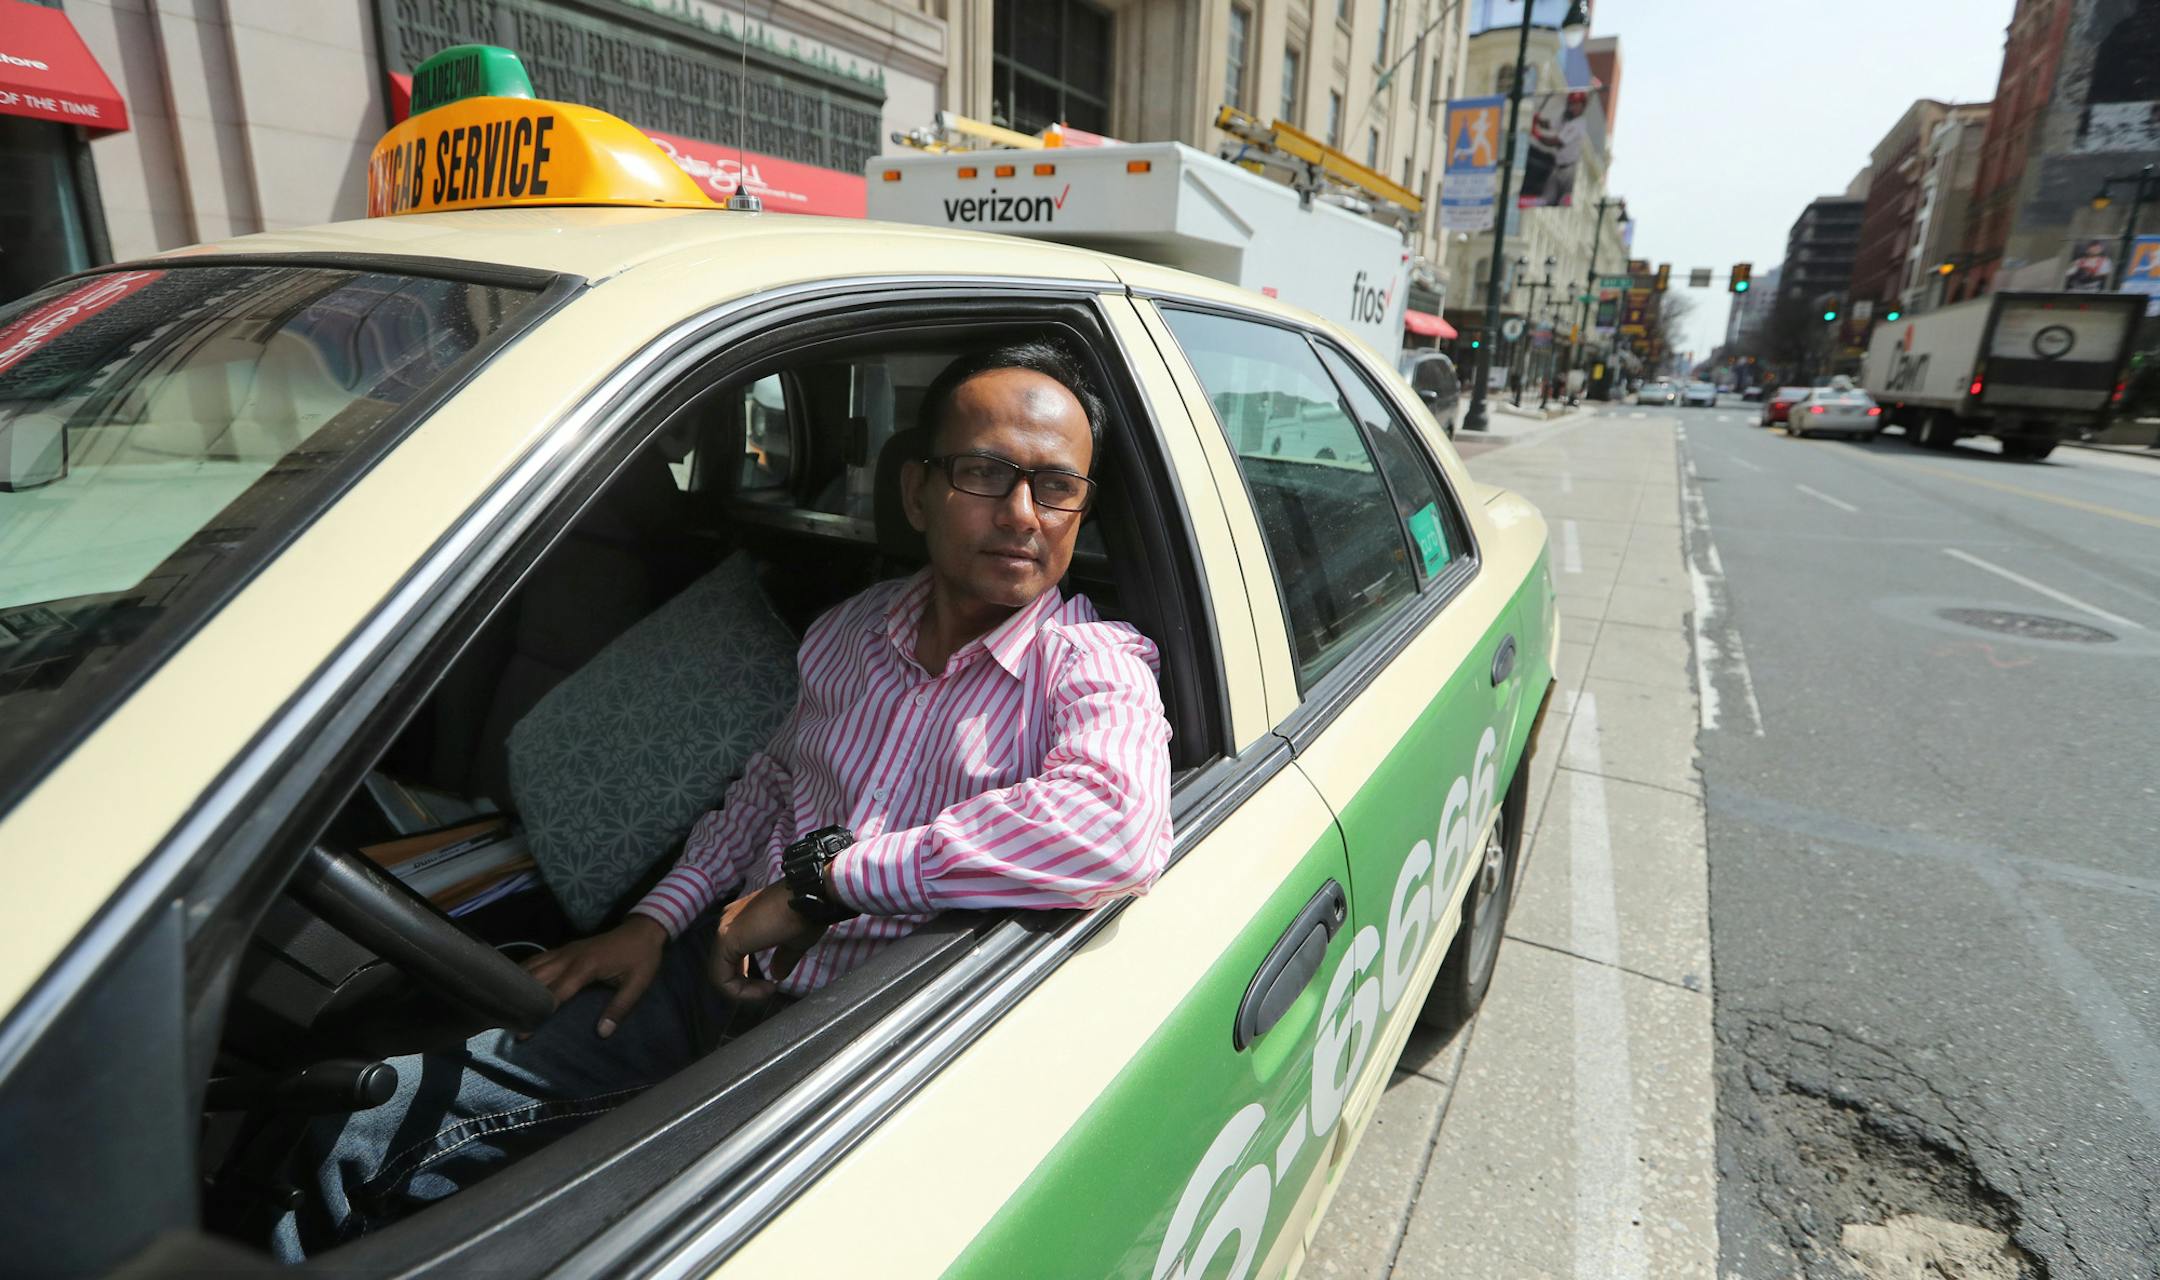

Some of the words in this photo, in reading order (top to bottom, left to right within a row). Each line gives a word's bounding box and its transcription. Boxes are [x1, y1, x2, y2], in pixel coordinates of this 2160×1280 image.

[23, 94, 58, 112] THE
[432, 116, 554, 205] SERVICE
[943, 187, 1054, 222] verizon
[1351, 271, 1385, 324] fios
